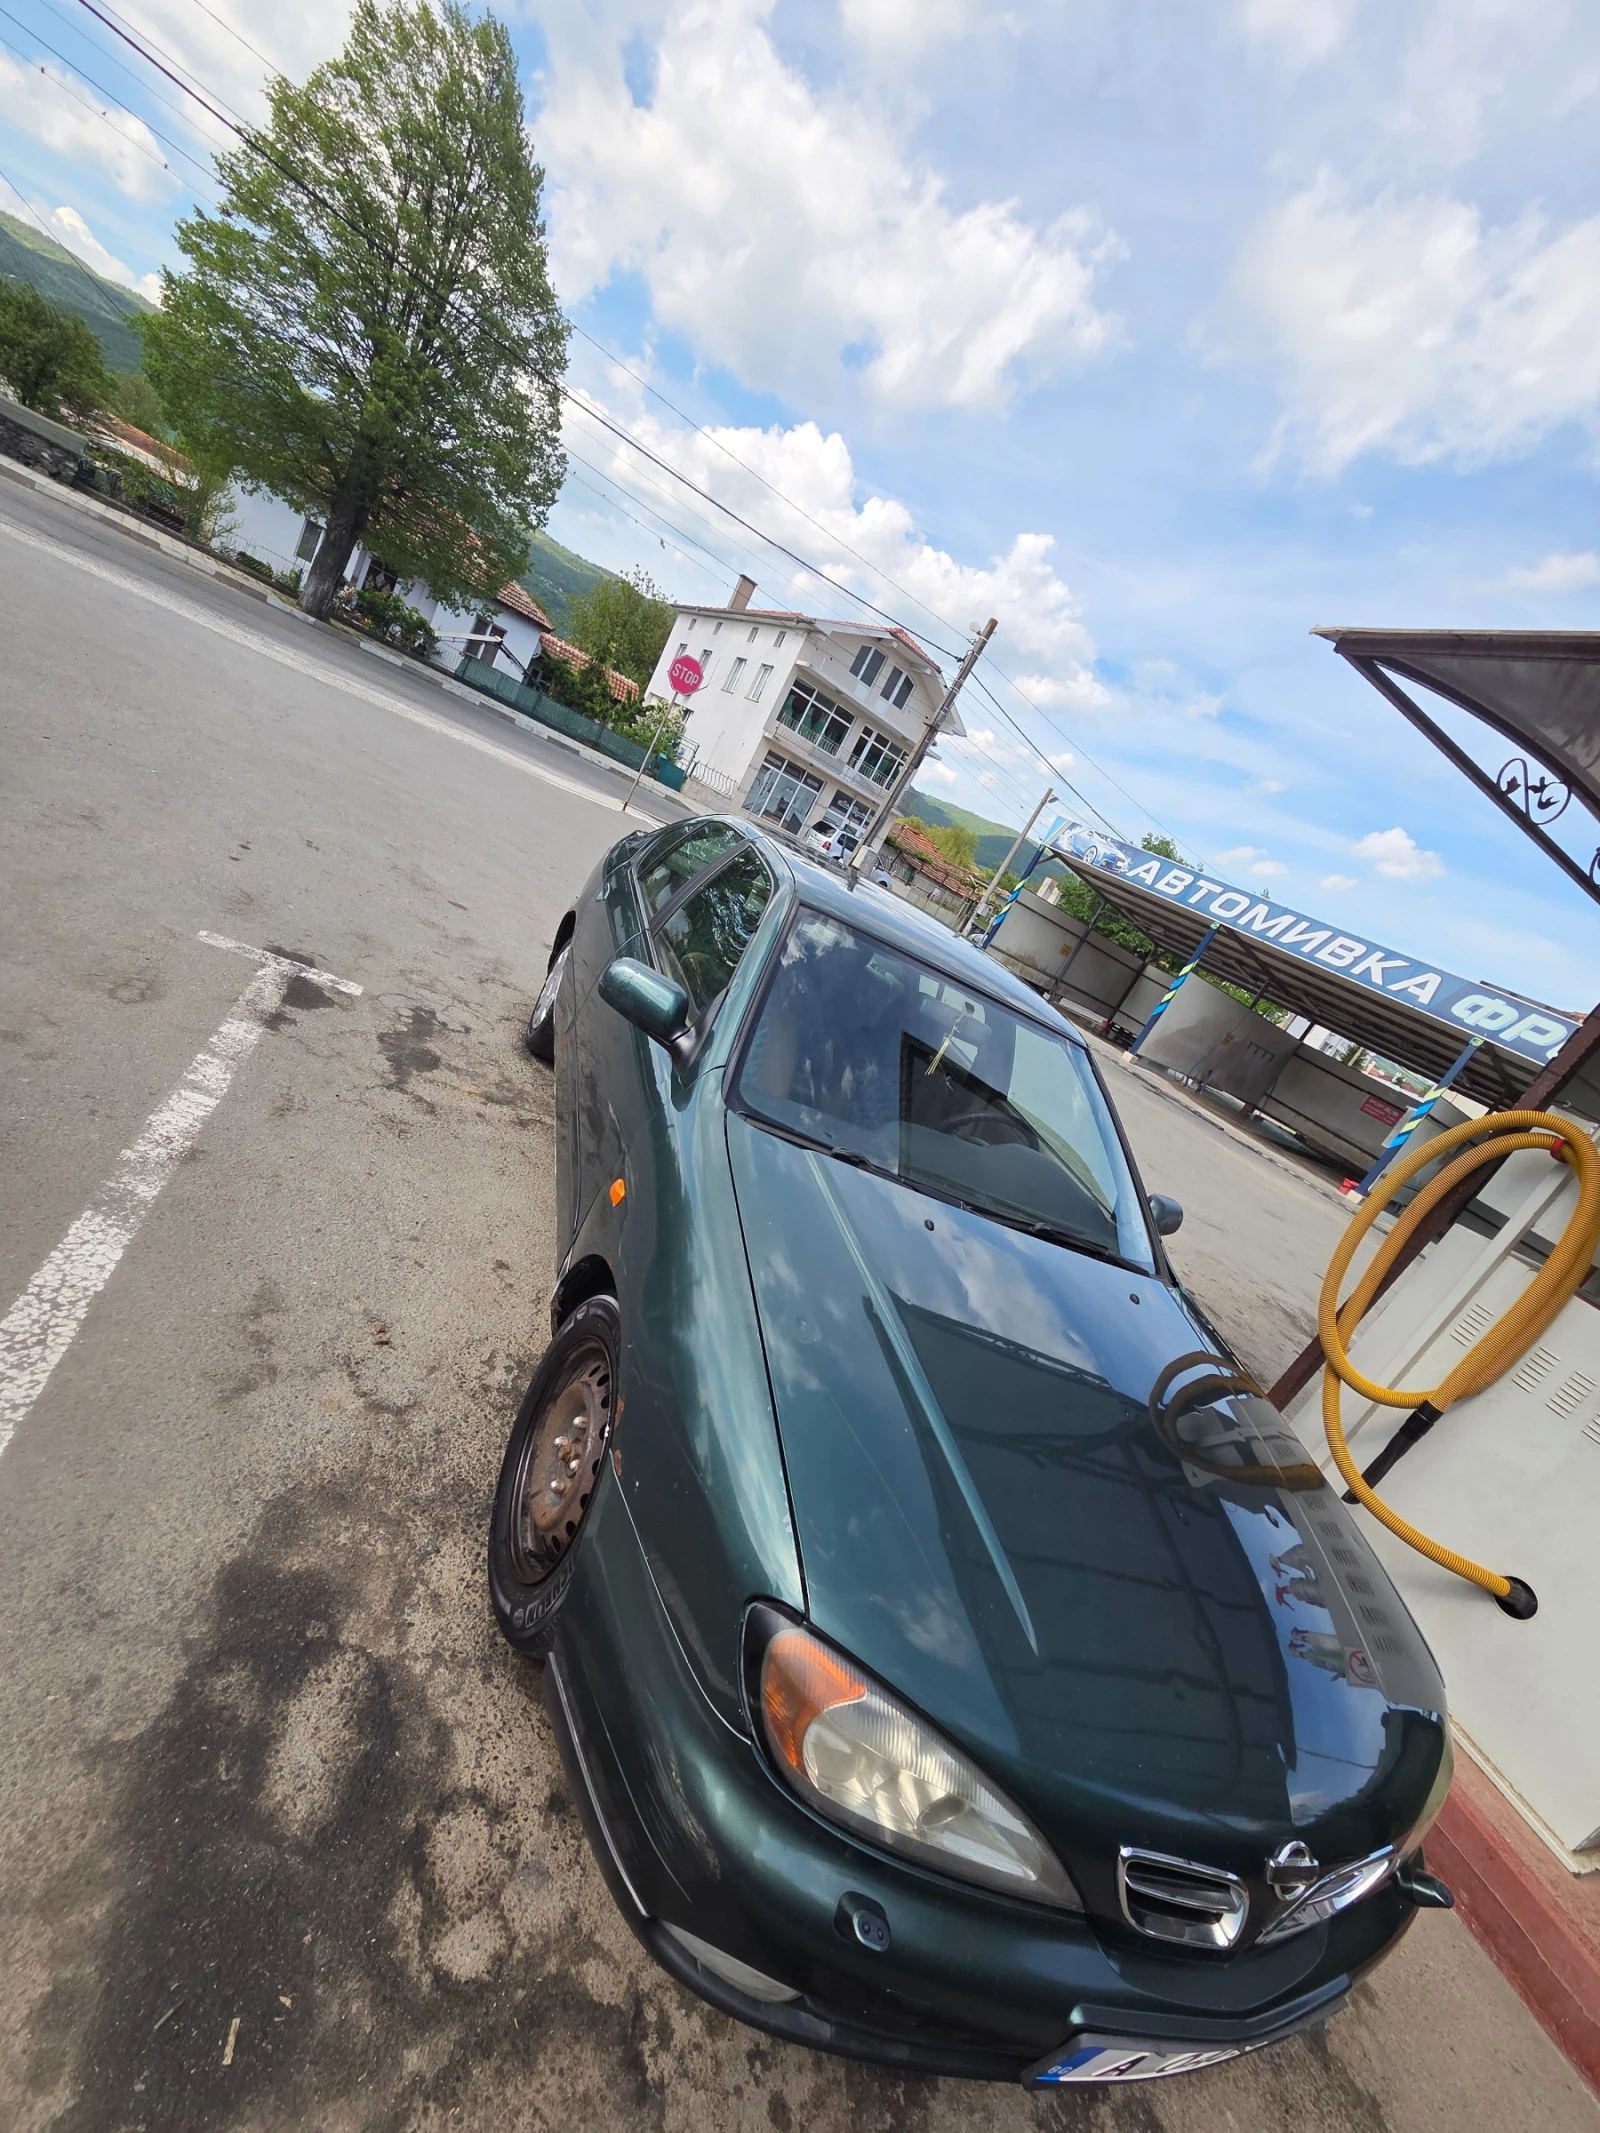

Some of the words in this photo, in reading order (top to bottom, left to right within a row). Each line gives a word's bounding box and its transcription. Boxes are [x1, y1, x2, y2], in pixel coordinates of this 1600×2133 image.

[672, 663, 699, 686] STOP
[1126, 860, 1443, 1005] АВТОМИВКА
[1451, 994, 1567, 1060] ФР
[1047, 2065, 1073, 2075] BG
